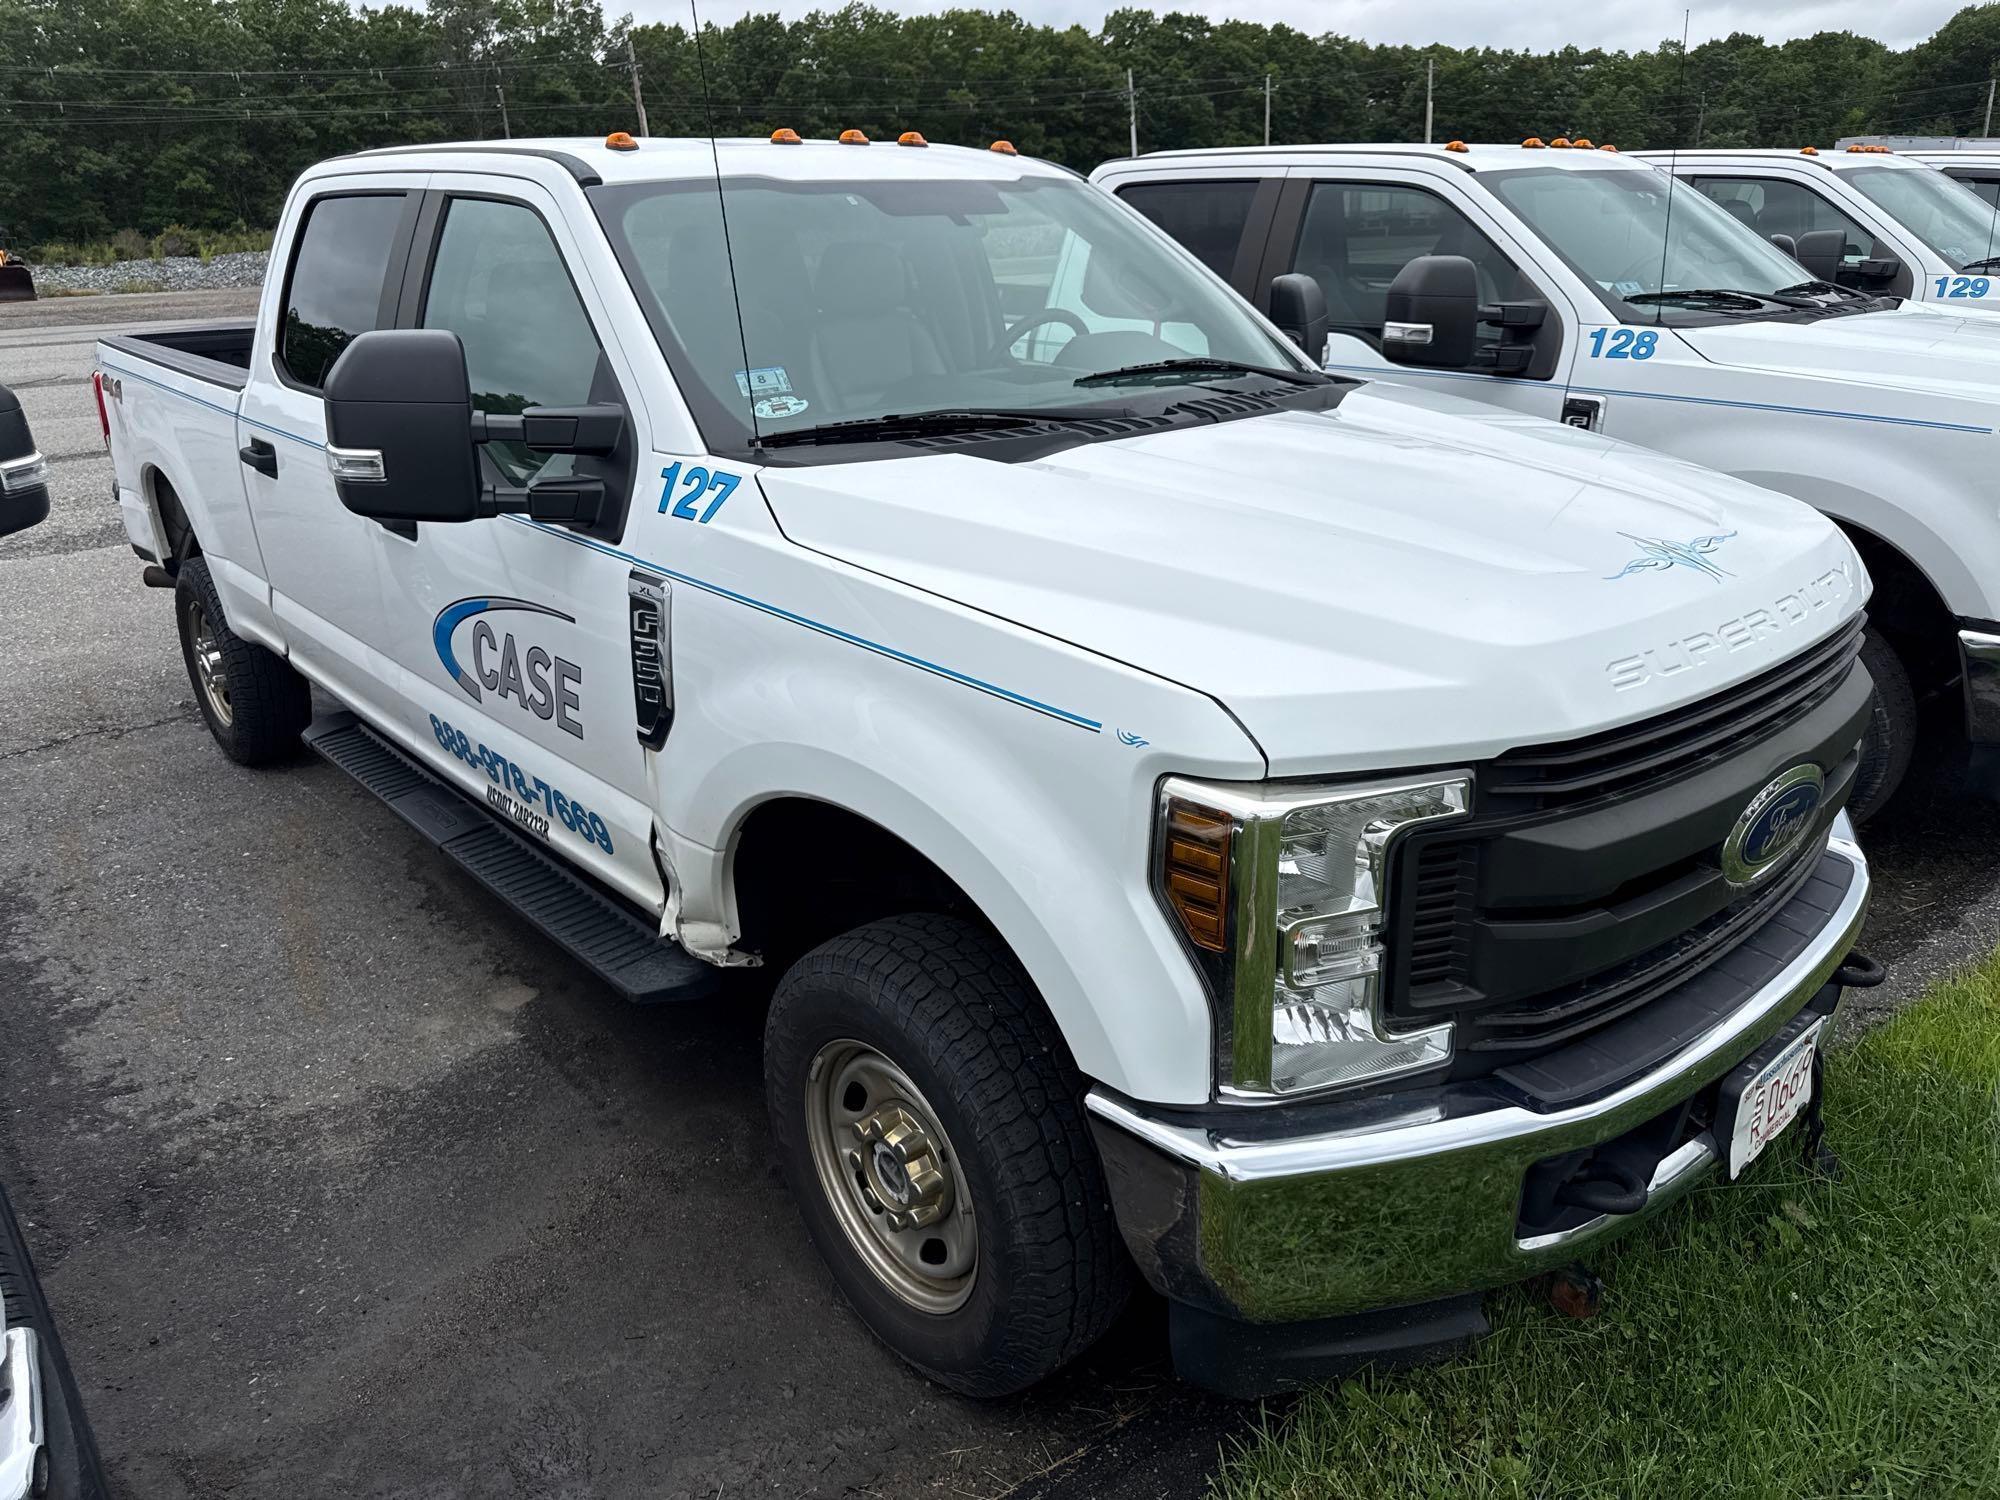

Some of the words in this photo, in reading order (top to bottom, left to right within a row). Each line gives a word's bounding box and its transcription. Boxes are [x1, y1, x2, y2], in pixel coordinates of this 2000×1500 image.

[1935, 276, 1990, 298] 129
[1590, 328, 1659, 360] 128
[658, 461, 742, 524] 127
[639, 586, 652, 597] XL
[1606, 608, 1782, 692] SUPER
[1775, 561, 1855, 626] DUTY
[472, 619, 584, 741] CASE
[429, 713, 614, 855] 888-978-7669
[1761, 797, 1809, 856] Ford
[1767, 1047, 1814, 1124] D669
